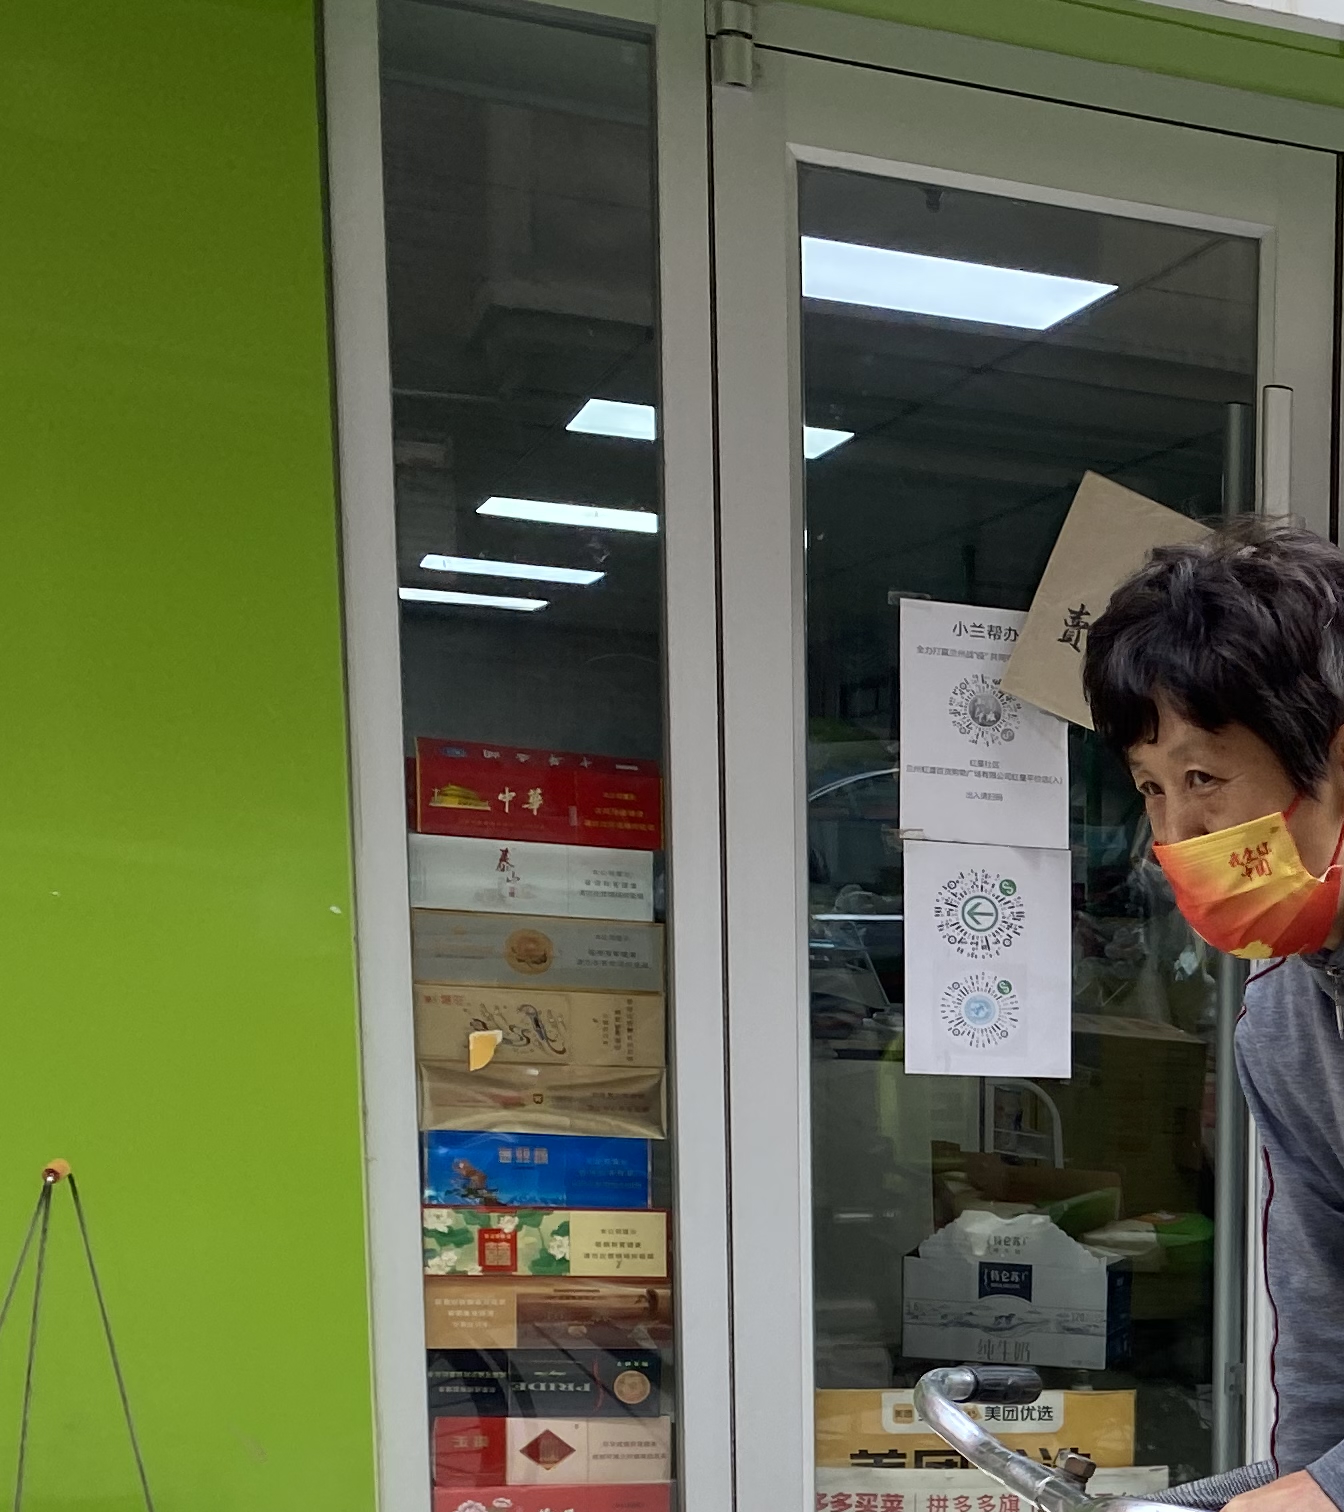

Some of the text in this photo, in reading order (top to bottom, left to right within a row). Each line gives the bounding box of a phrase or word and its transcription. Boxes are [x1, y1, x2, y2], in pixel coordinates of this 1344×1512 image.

[952, 620, 1020, 642] 小兰帮办
[984, 1405, 1054, 1423] 美团优选
